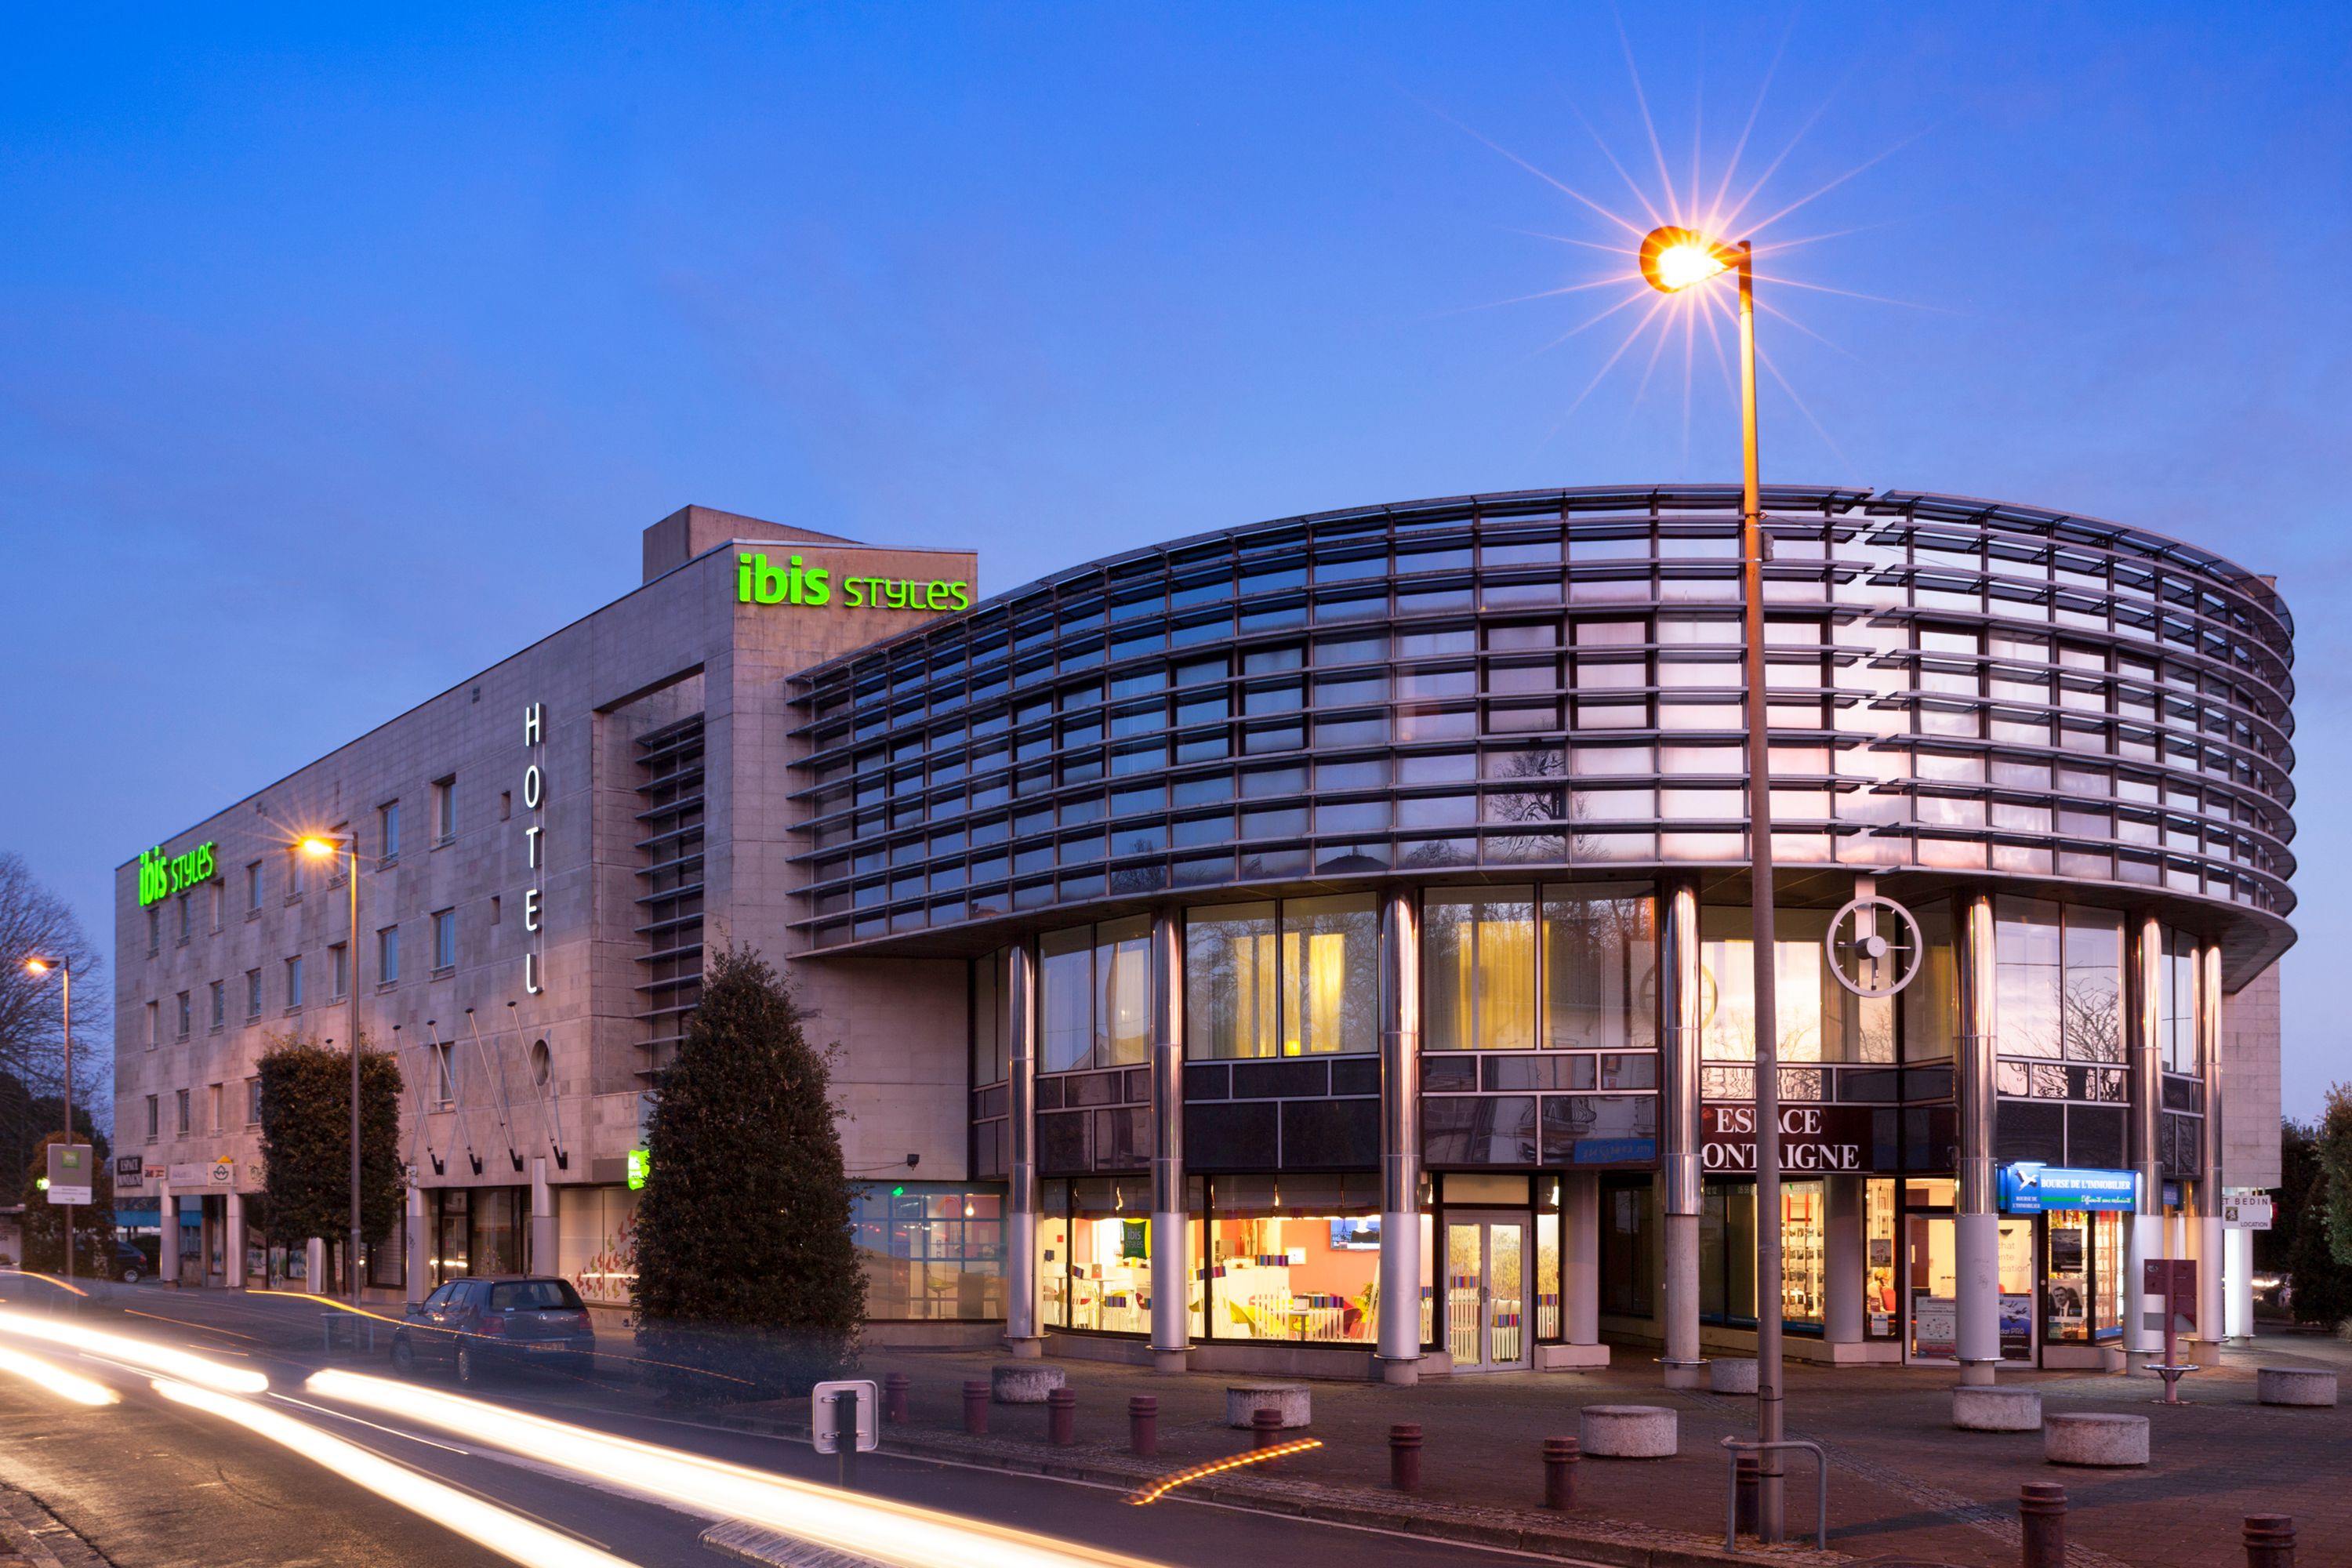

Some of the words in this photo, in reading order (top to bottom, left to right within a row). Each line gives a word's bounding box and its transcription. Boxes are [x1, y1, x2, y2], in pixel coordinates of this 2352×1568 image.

[739, 553, 830, 605] ibis
[524, 702, 540, 994] HOTEL
[140, 845, 168, 907] ibis
[1715, 1108, 1822, 1134] ESCE
[1702, 1142, 1860, 1168] ONTIGNE
[2041, 1179, 2070, 1189] BOURSE
[2071, 1180, 2080, 1189] DE
[2082, 1180, 2131, 1189] L'IMMOBILIER
[1127, 1228, 1142, 1240] ibis
